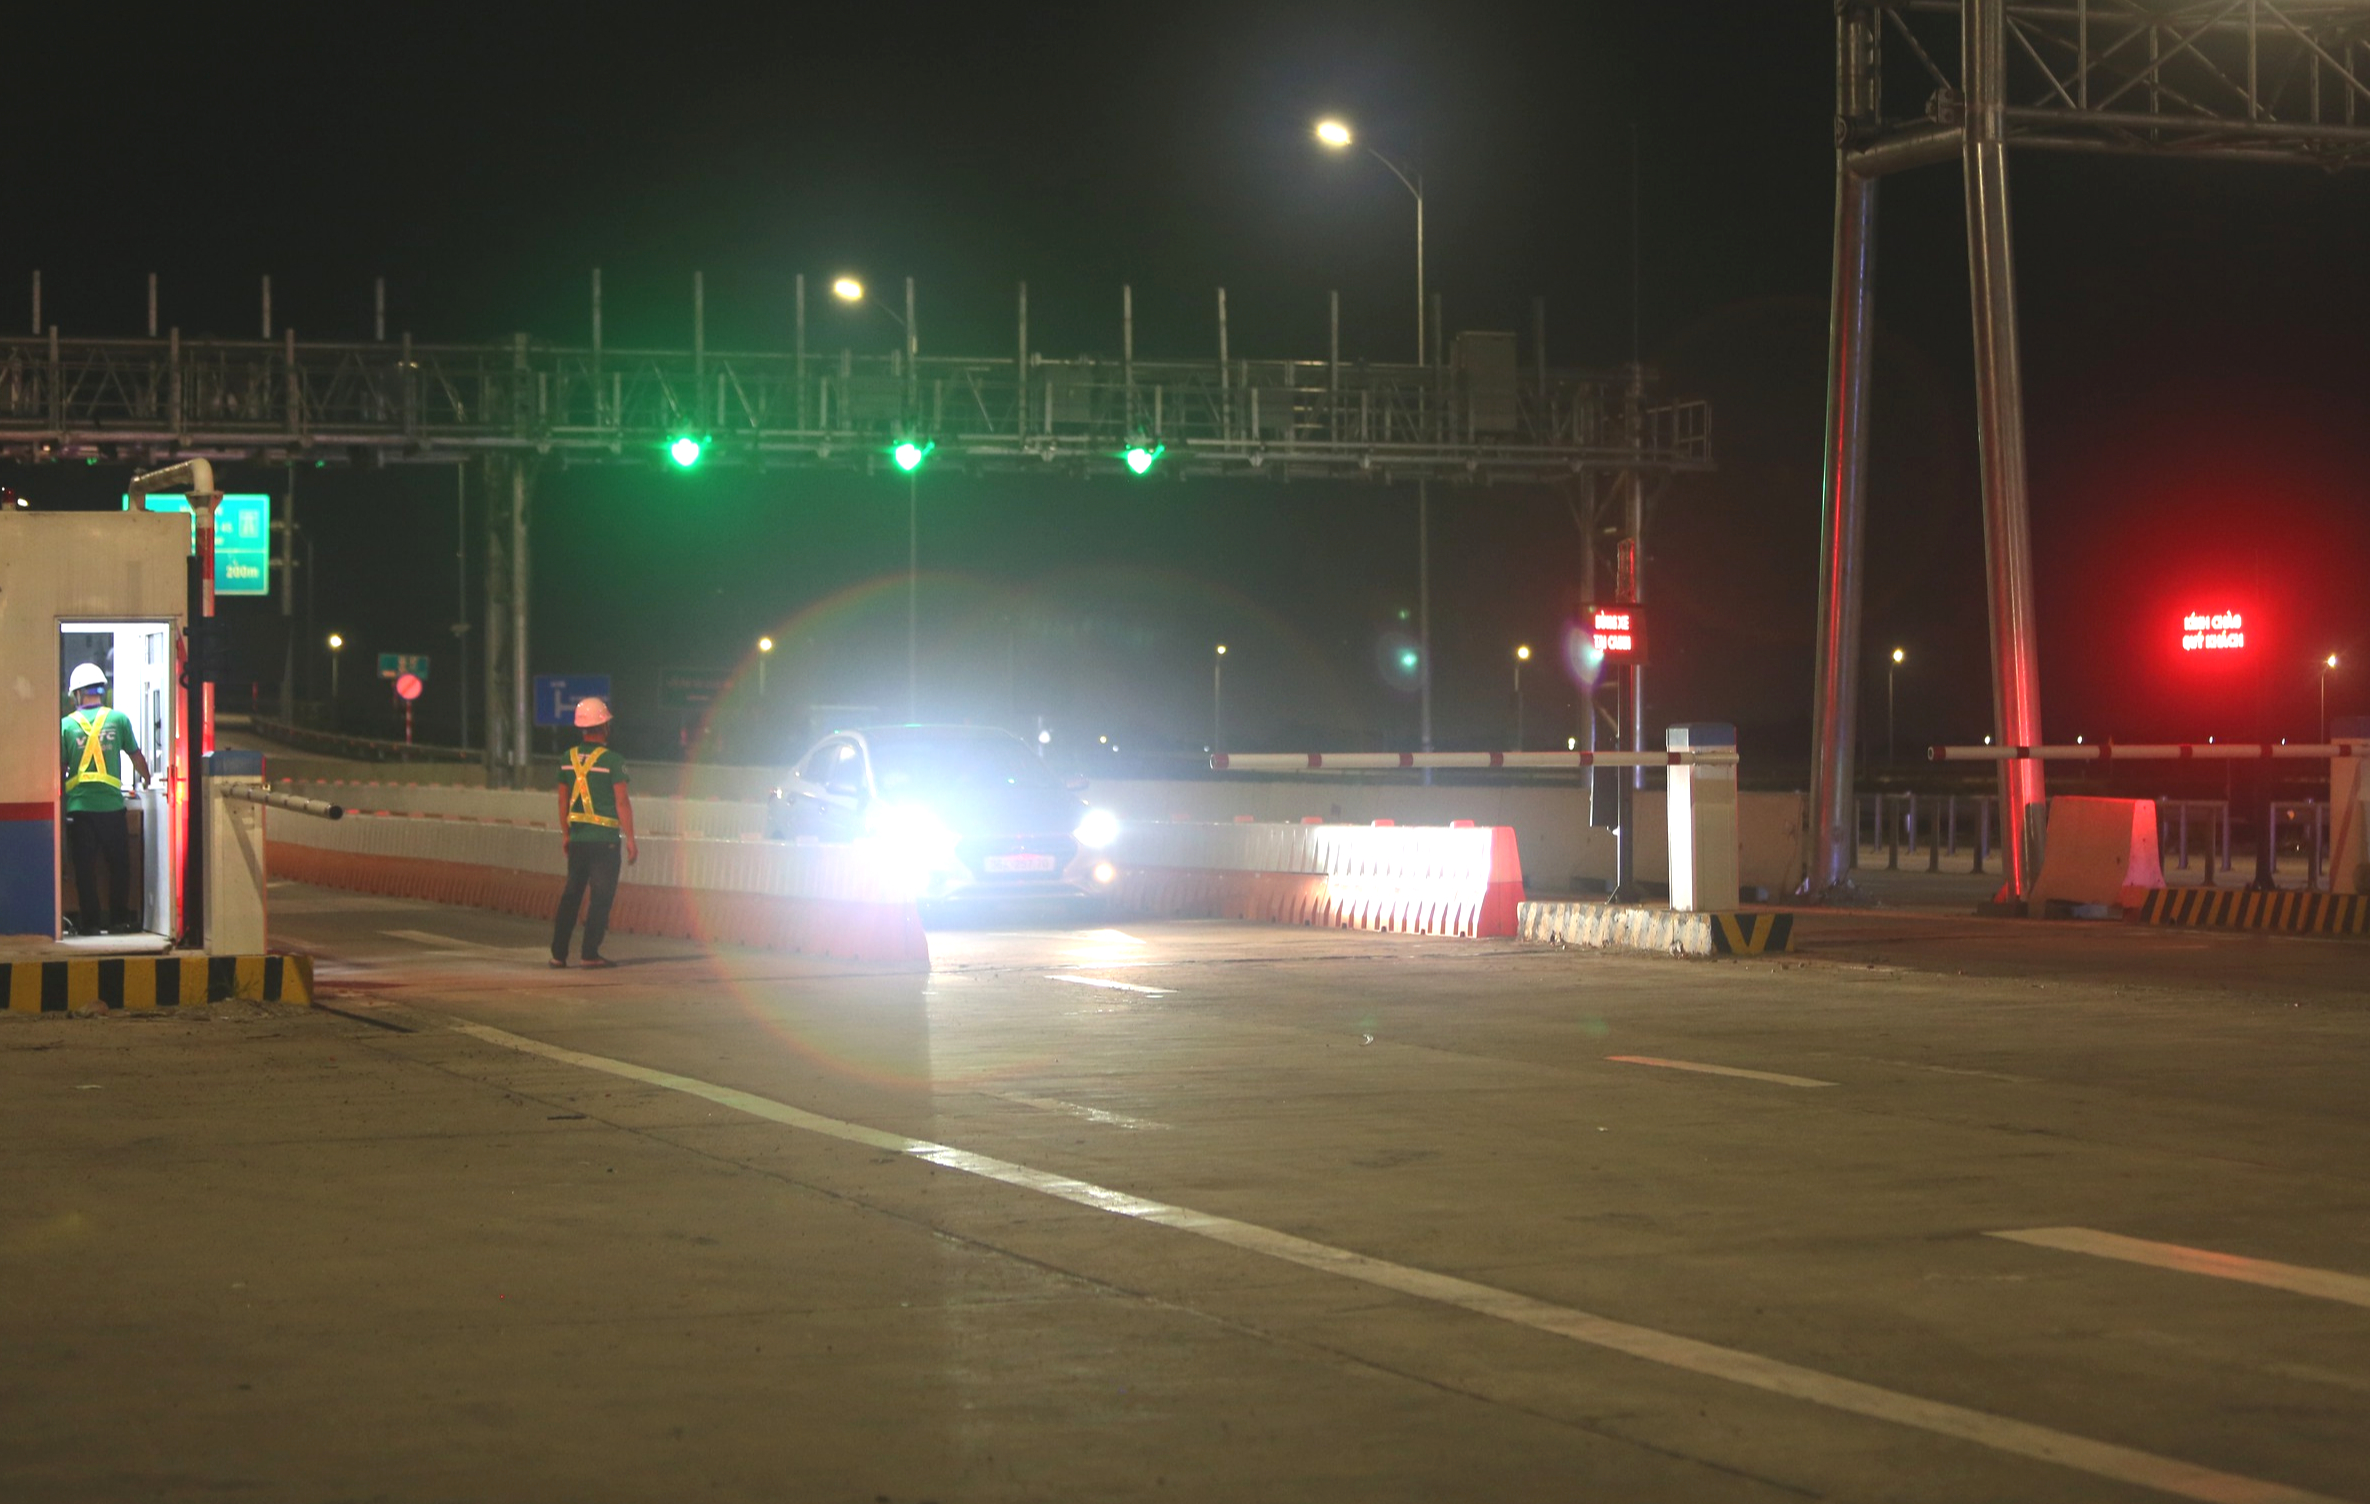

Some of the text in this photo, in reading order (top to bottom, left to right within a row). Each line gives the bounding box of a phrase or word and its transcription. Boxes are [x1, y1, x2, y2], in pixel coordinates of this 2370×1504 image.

[226, 565, 258, 578] 200m
[1618, 616, 1629, 630] XE
[76, 730, 116, 746] VTC
